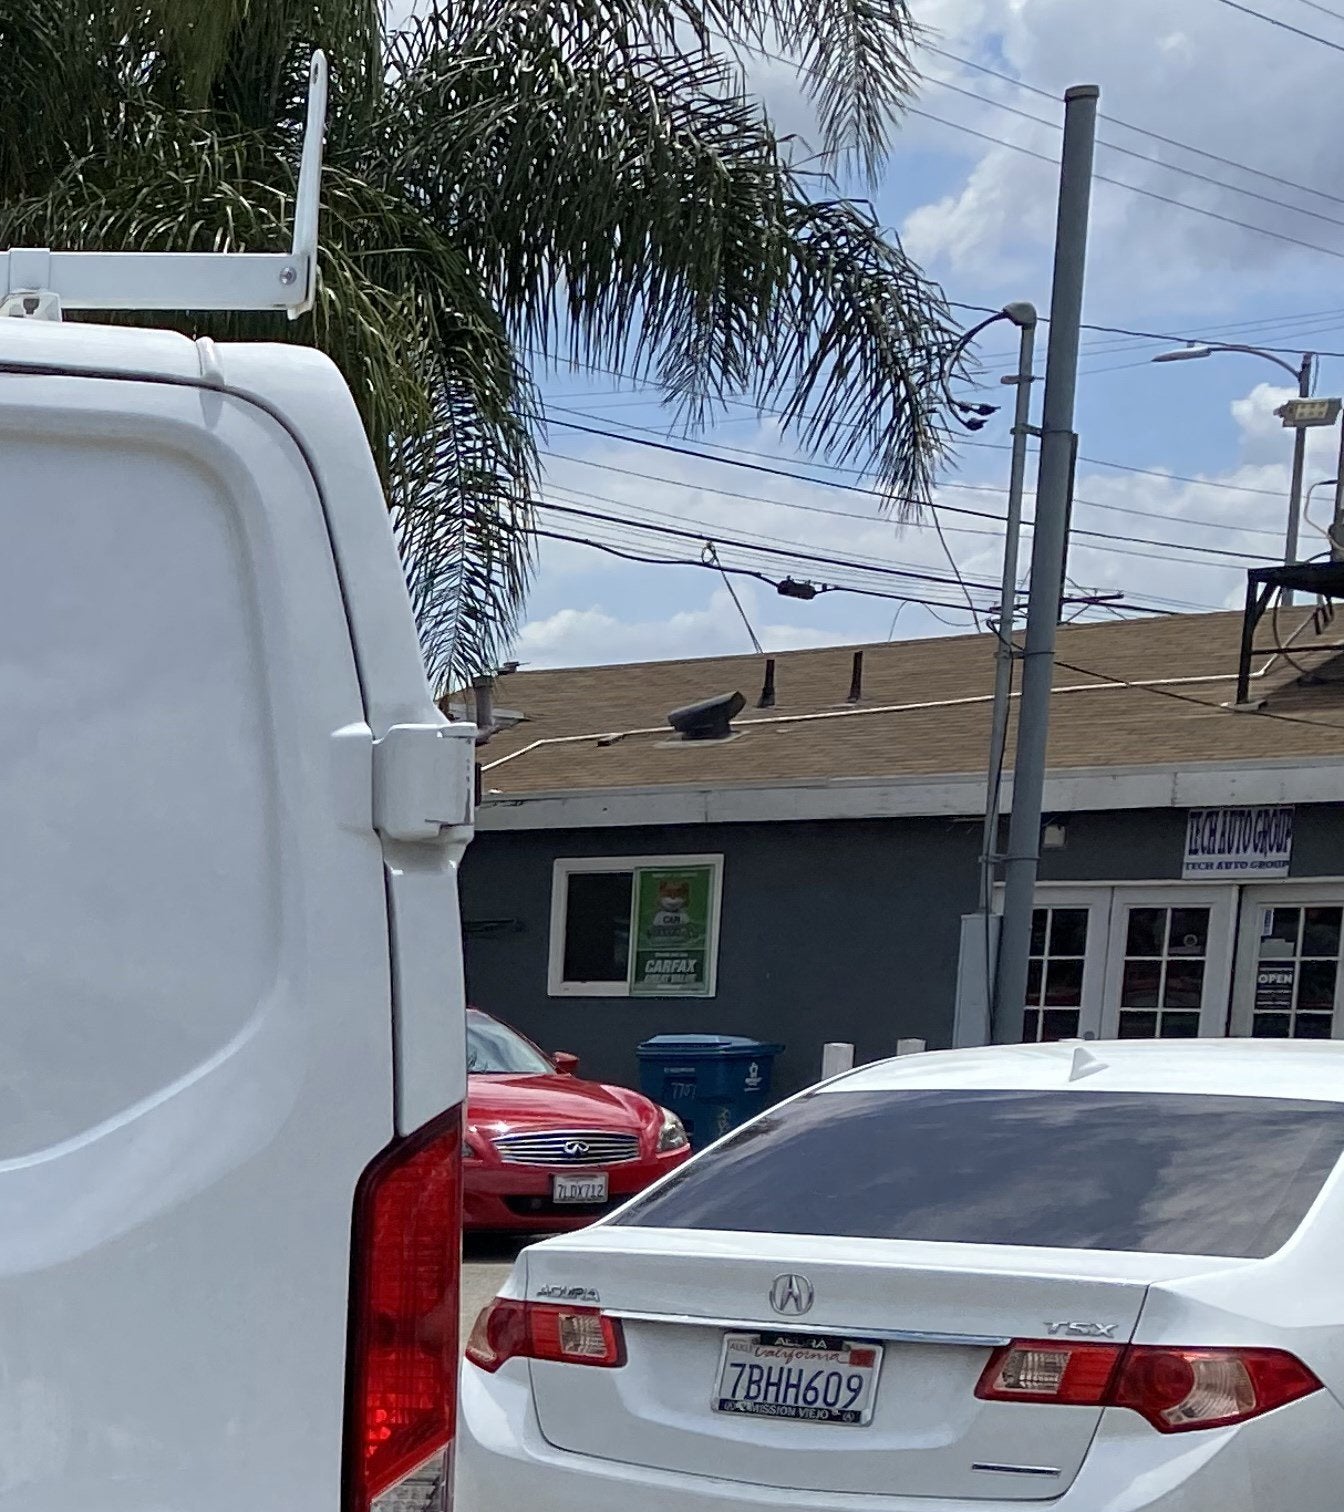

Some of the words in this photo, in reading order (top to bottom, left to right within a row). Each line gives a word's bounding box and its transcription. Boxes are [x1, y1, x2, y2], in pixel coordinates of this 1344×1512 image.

[1188, 811, 1217, 855] TECH
[1217, 810, 1253, 854] AUTO
[1253, 808, 1293, 857] GROUP
[1185, 861, 1213, 871] TECH
[1216, 861, 1248, 870] AUTO
[1249, 860, 1289, 869] GROUP
[645, 960, 698, 973] CARFAX
[1258, 973, 1293, 984] OPEN
[1042, 1321, 1119, 1338] TSX
[754, 1347, 849, 1365] California
[730, 1362, 863, 1409] 7BHH609
[798, 1407, 829, 1420] VIEJO
